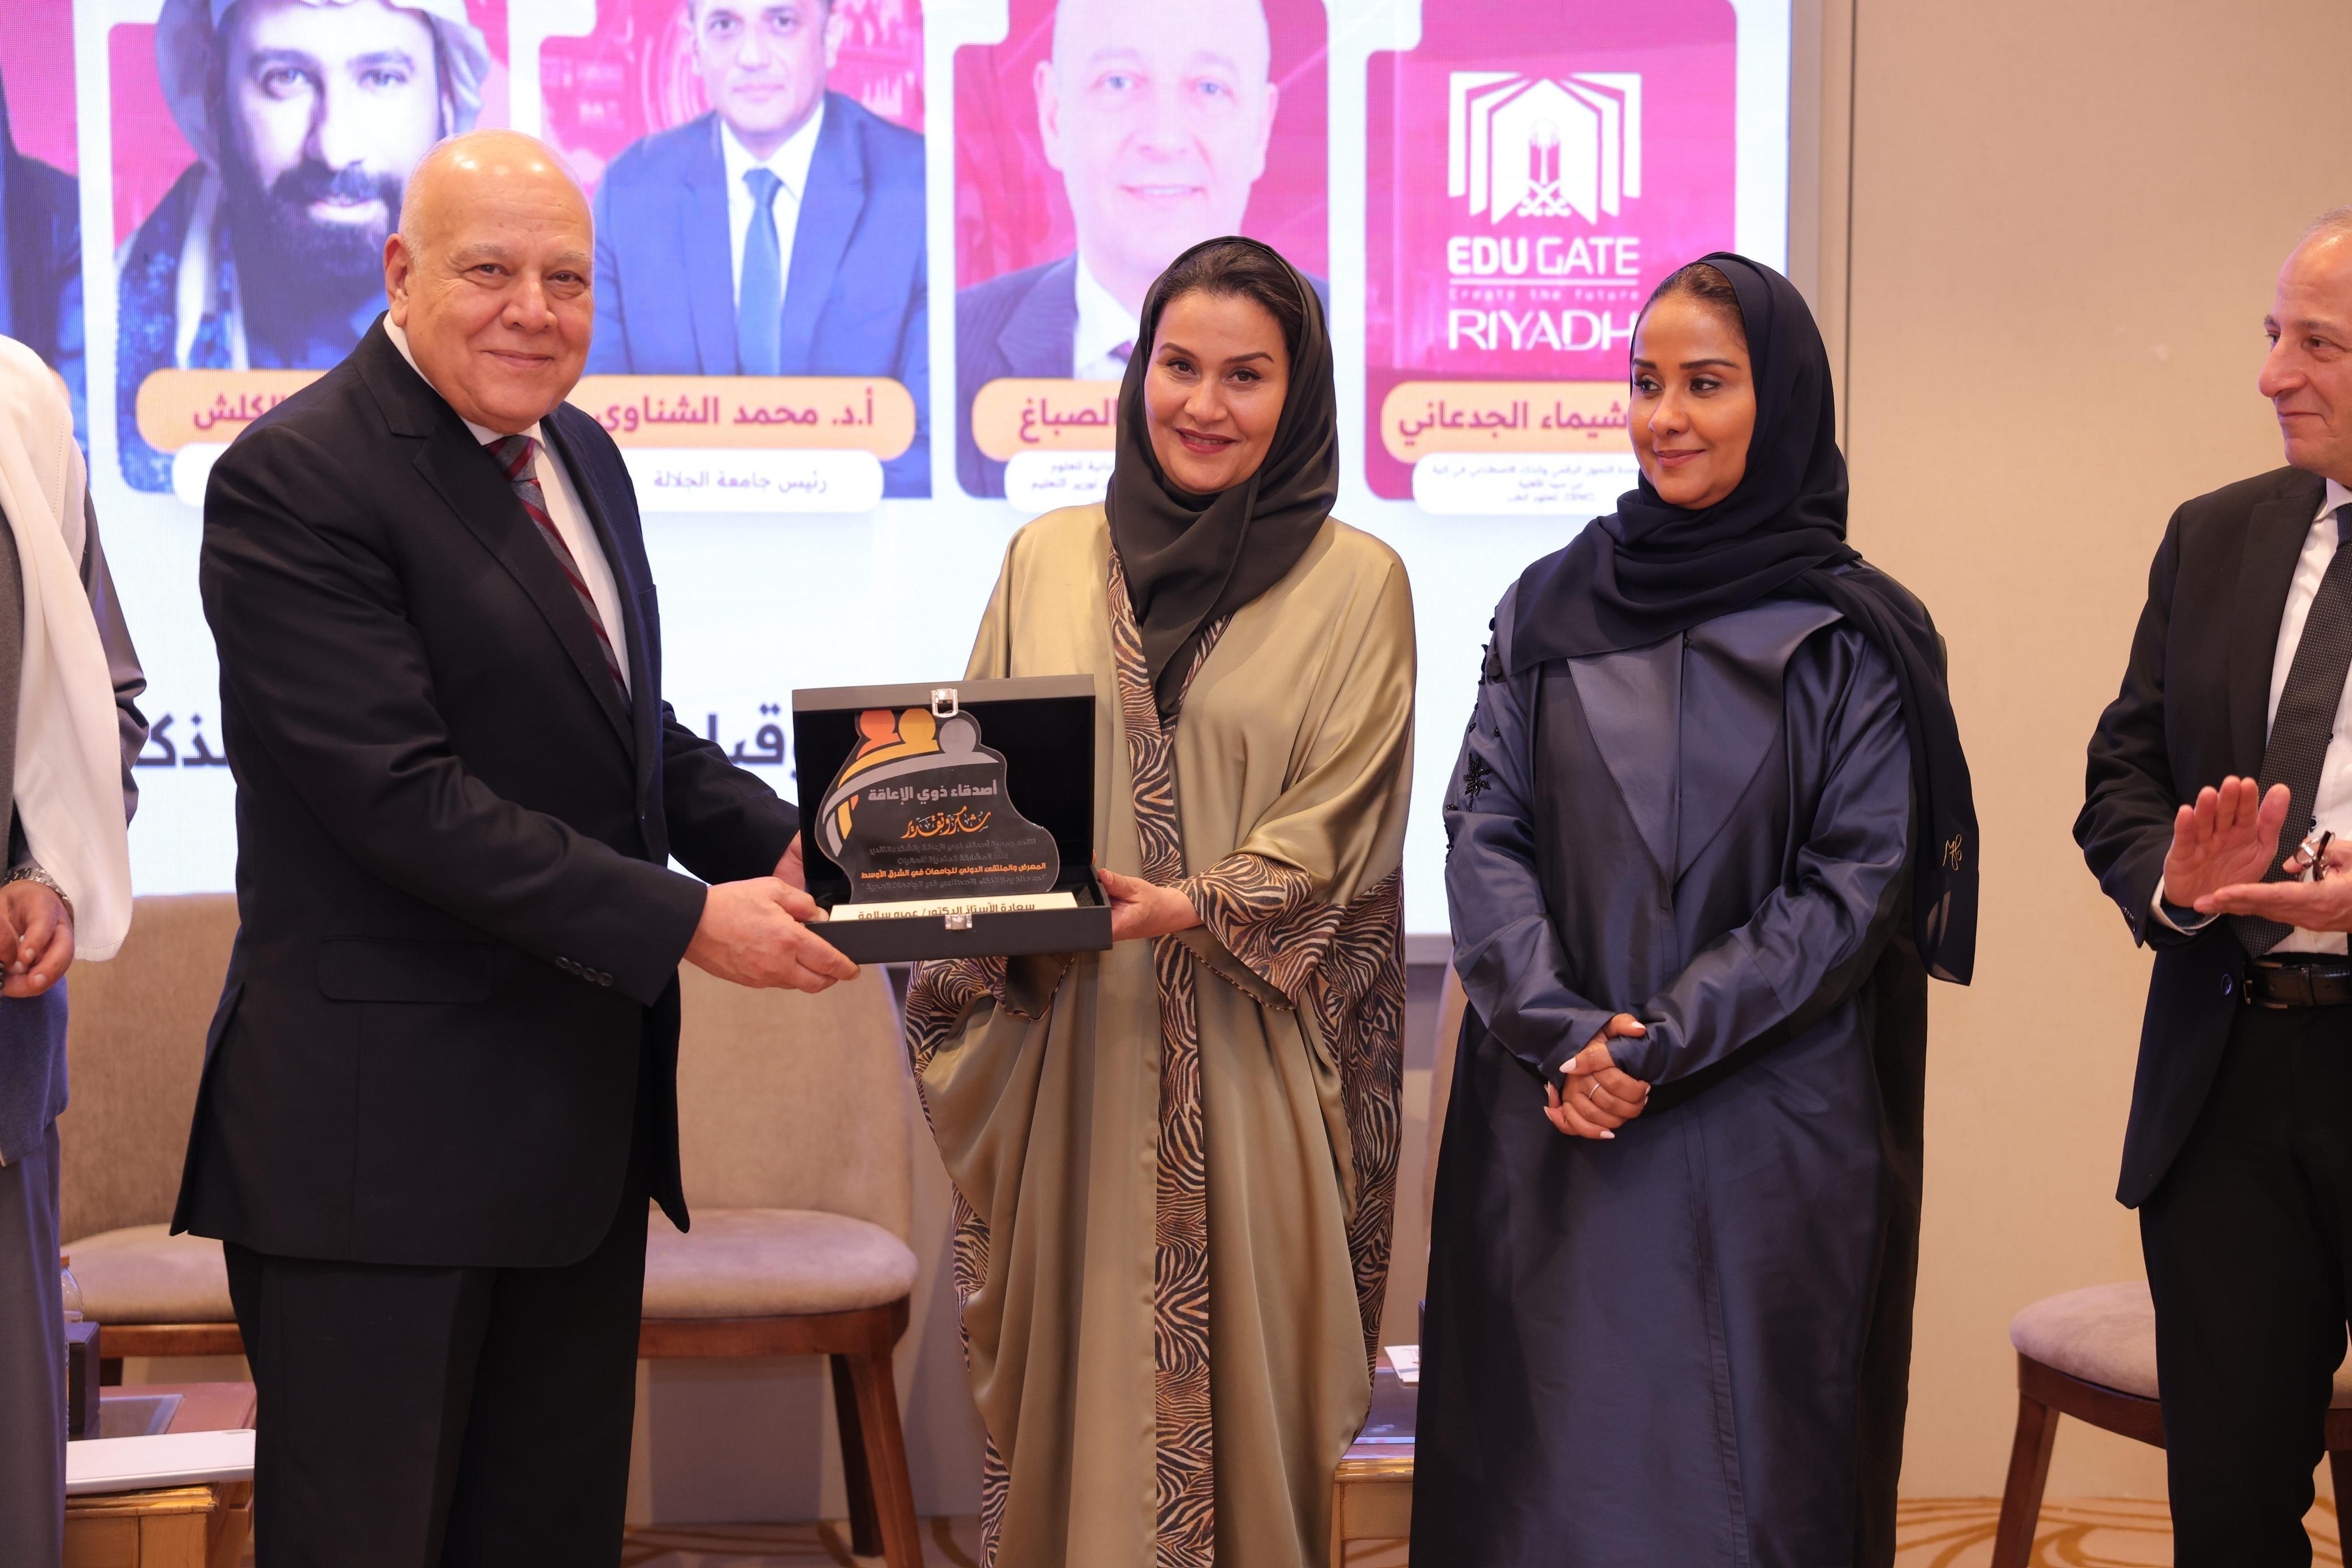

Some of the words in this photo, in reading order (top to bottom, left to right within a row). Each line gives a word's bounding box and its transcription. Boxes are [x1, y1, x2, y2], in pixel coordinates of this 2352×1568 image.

[1448, 236, 1528, 275] EDU
[1537, 236, 1640, 275] GATE
[1448, 309, 1639, 351] RIYADH
[733, 402, 818, 426] محمد
[1019, 397, 1118, 443] الصباغ
[1399, 400, 1528, 447] الجدعاني
[1541, 401, 1627, 439] شيماء
[654, 471, 708, 491] الجلالة
[717, 471, 771, 491] جامعة
[779, 470, 827, 493] رئيس
[868, 786, 914, 805] الإعاقة
[916, 785, 948, 805] ذوي
[950, 779, 997, 797] أصدقاء
[861, 869, 887, 880] الأوسط
[888, 868, 910, 878] الشرق
[911, 868, 924, 877] في
[925, 867, 957, 876] للجامعات
[958, 865, 983, 875] الدولي
[984, 864, 1017, 873] والملتقى
[1018, 861, 1046, 872] المعرض
[965, 902, 998, 914] الأستاذ
[1001, 903, 1035, 912] سعادة
